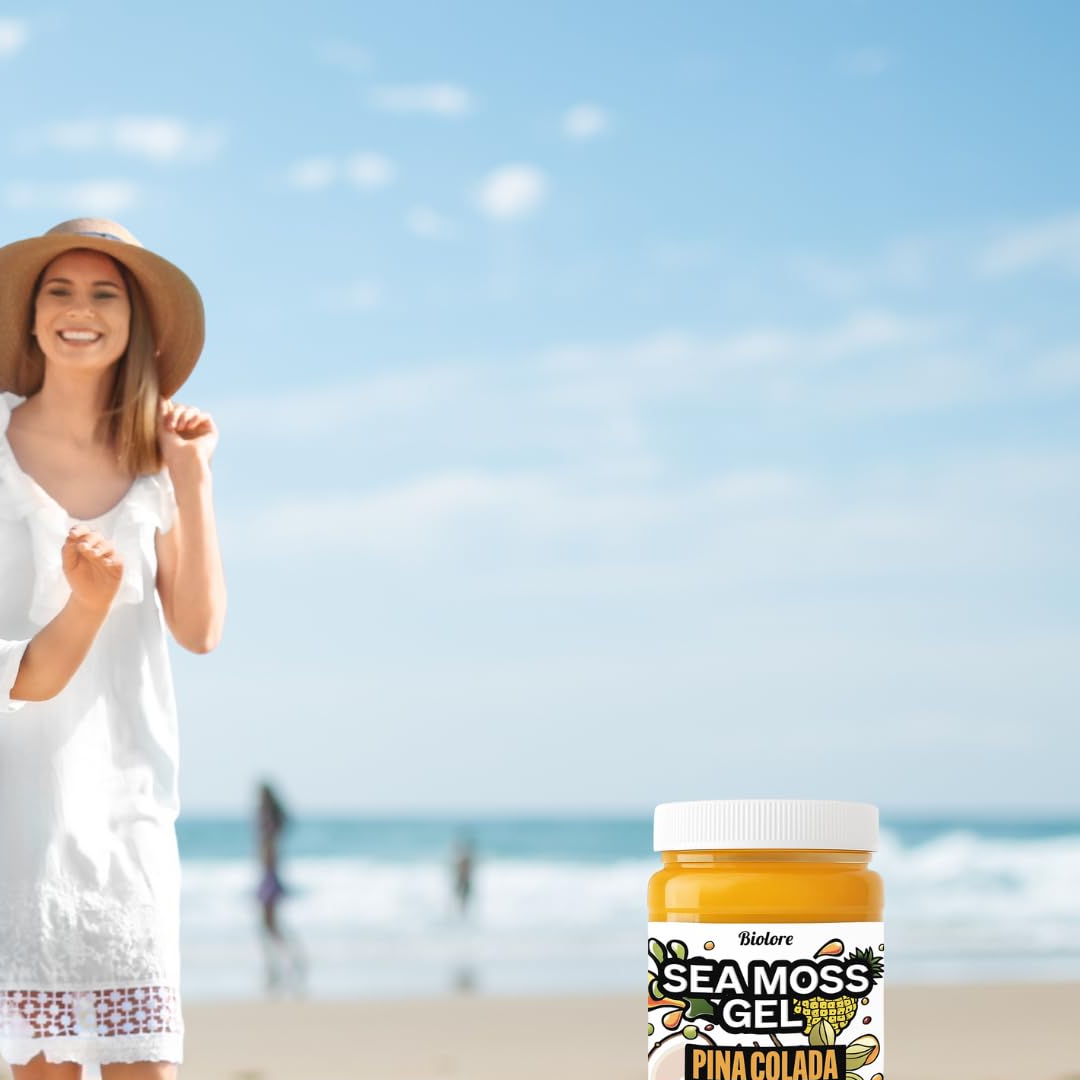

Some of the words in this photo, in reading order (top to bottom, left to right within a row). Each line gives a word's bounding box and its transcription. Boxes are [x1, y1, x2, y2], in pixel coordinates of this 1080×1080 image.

[738, 930, 794, 946] Biolore
[662, 963, 744, 994] SEA
[753, 963, 870, 995] MOSS
[722, 998, 803, 1029] GEL
[692, 1049, 747, 1080] PINA
